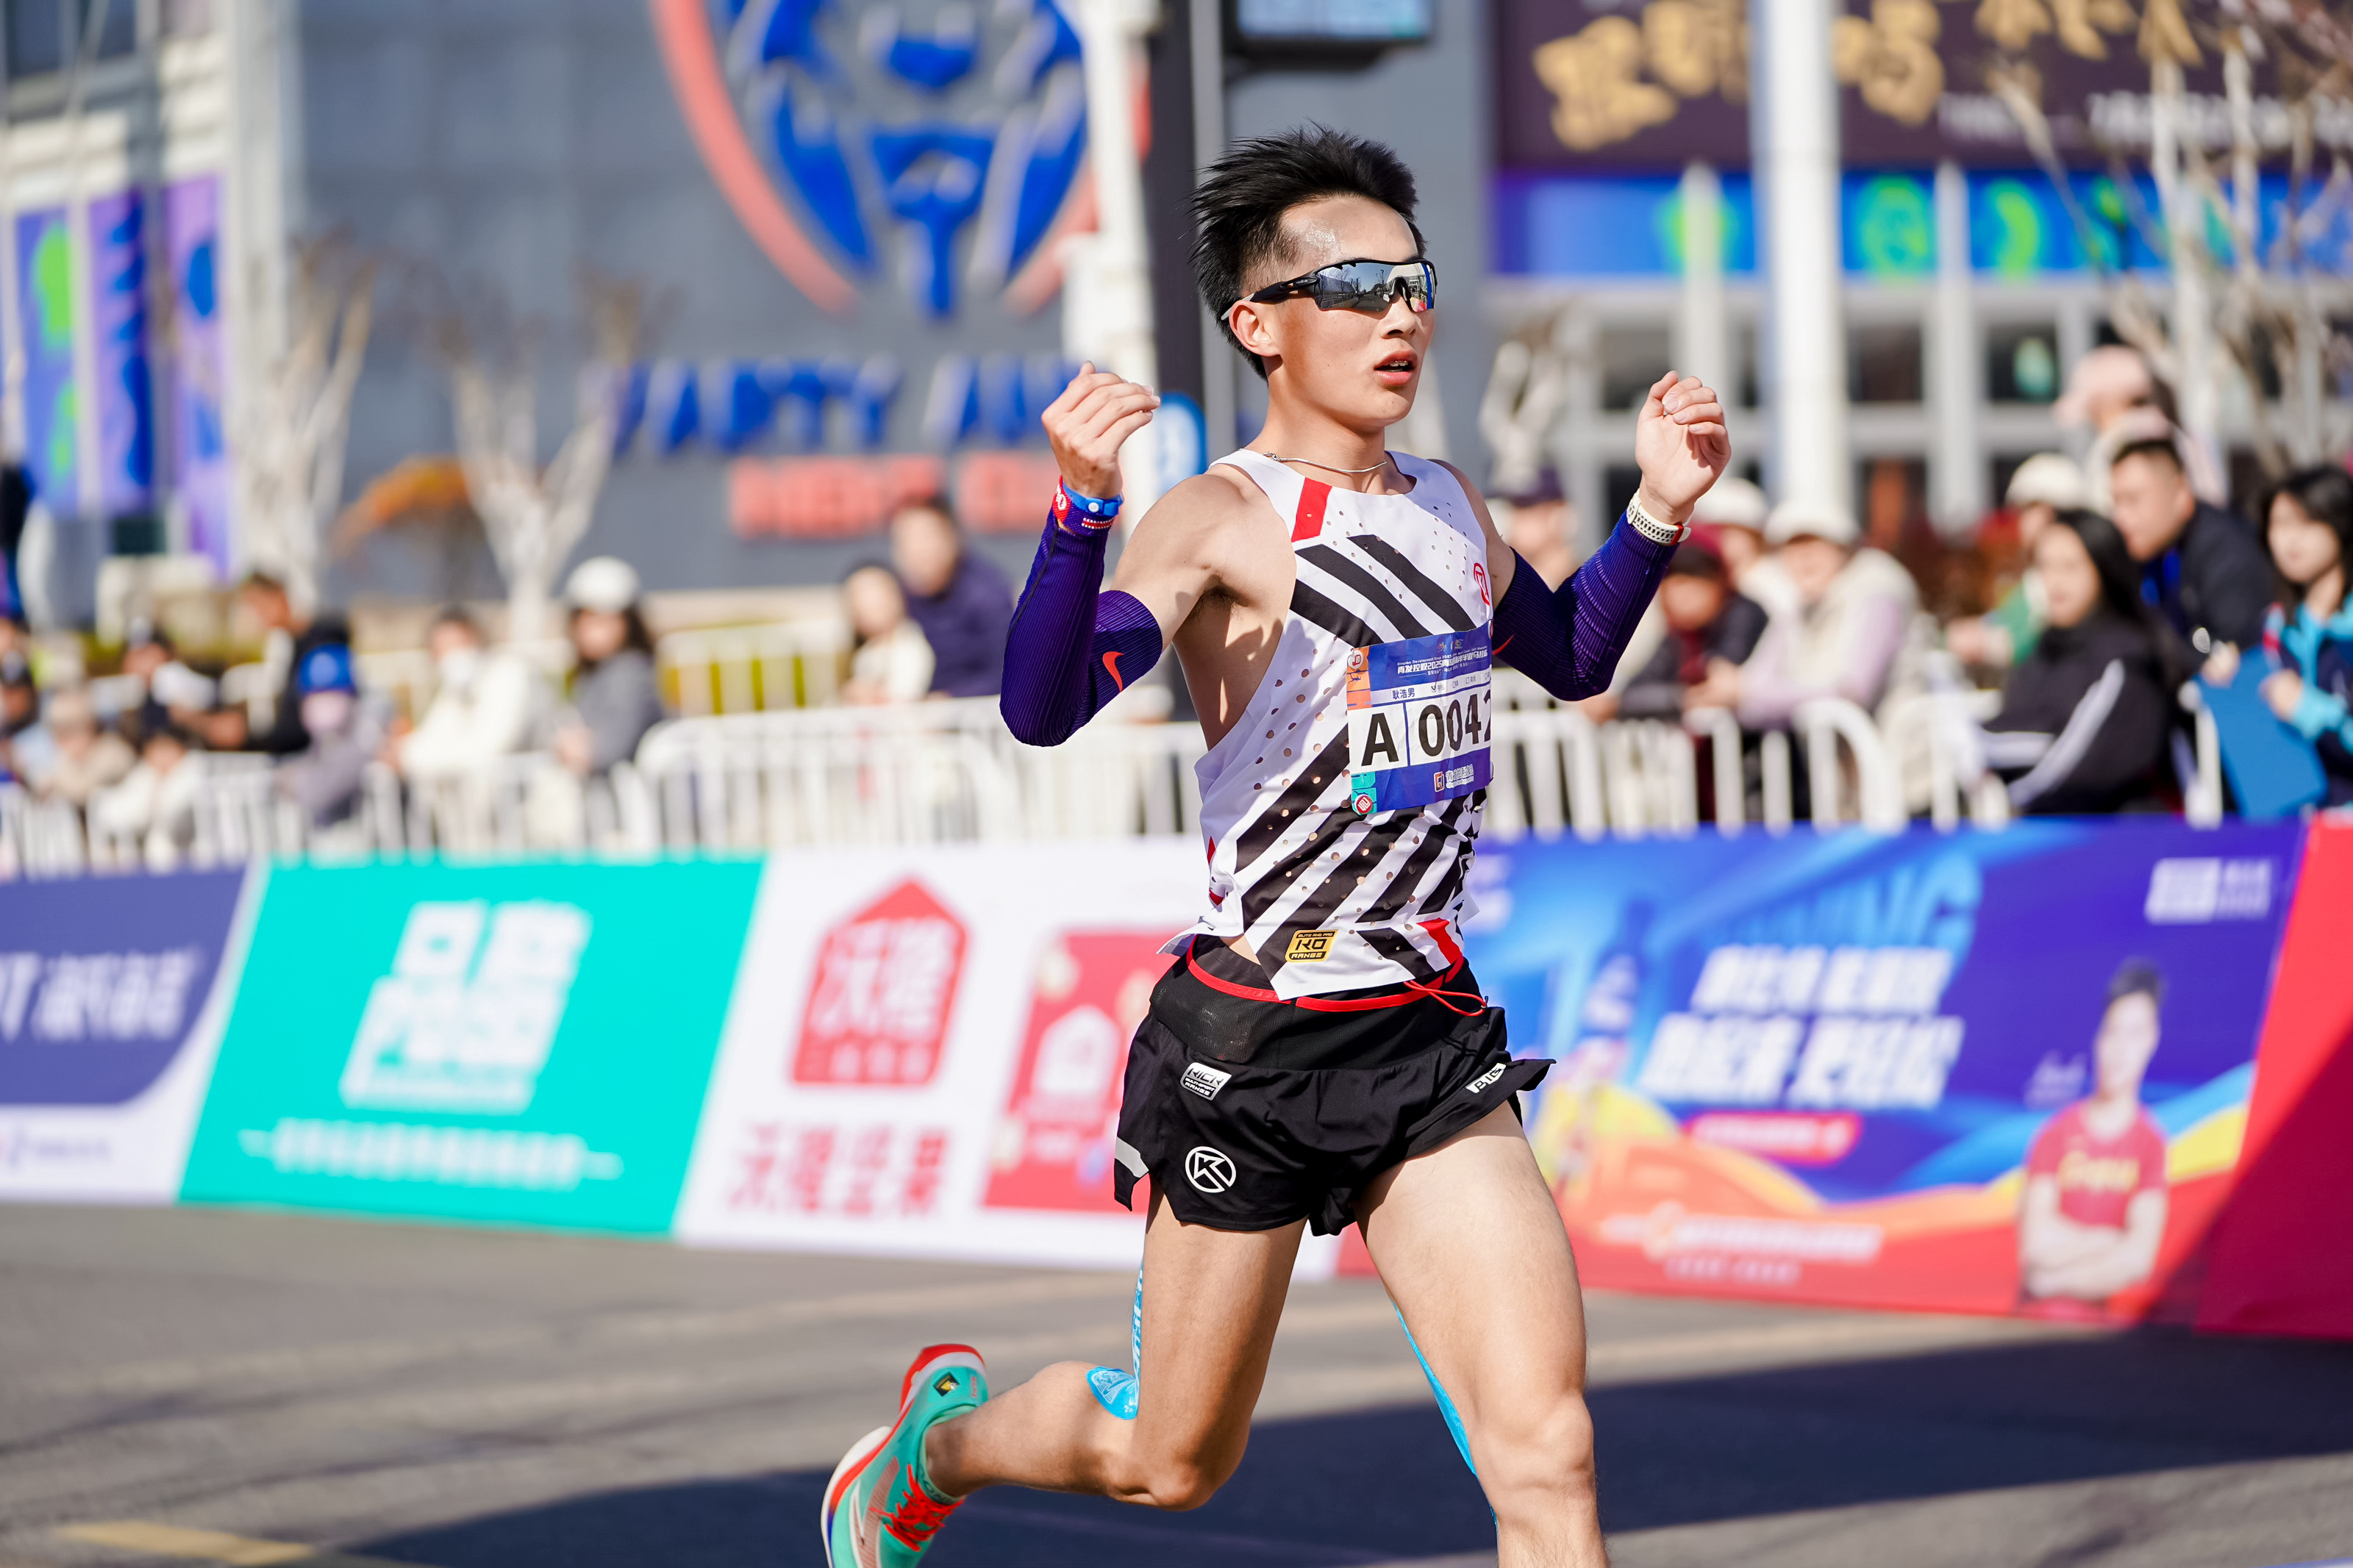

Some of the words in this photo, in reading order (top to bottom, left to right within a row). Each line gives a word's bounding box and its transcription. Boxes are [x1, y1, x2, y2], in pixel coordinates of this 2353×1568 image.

[1392, 687, 1415, 700] 耿浩男
[1361, 712, 1399, 767] A
